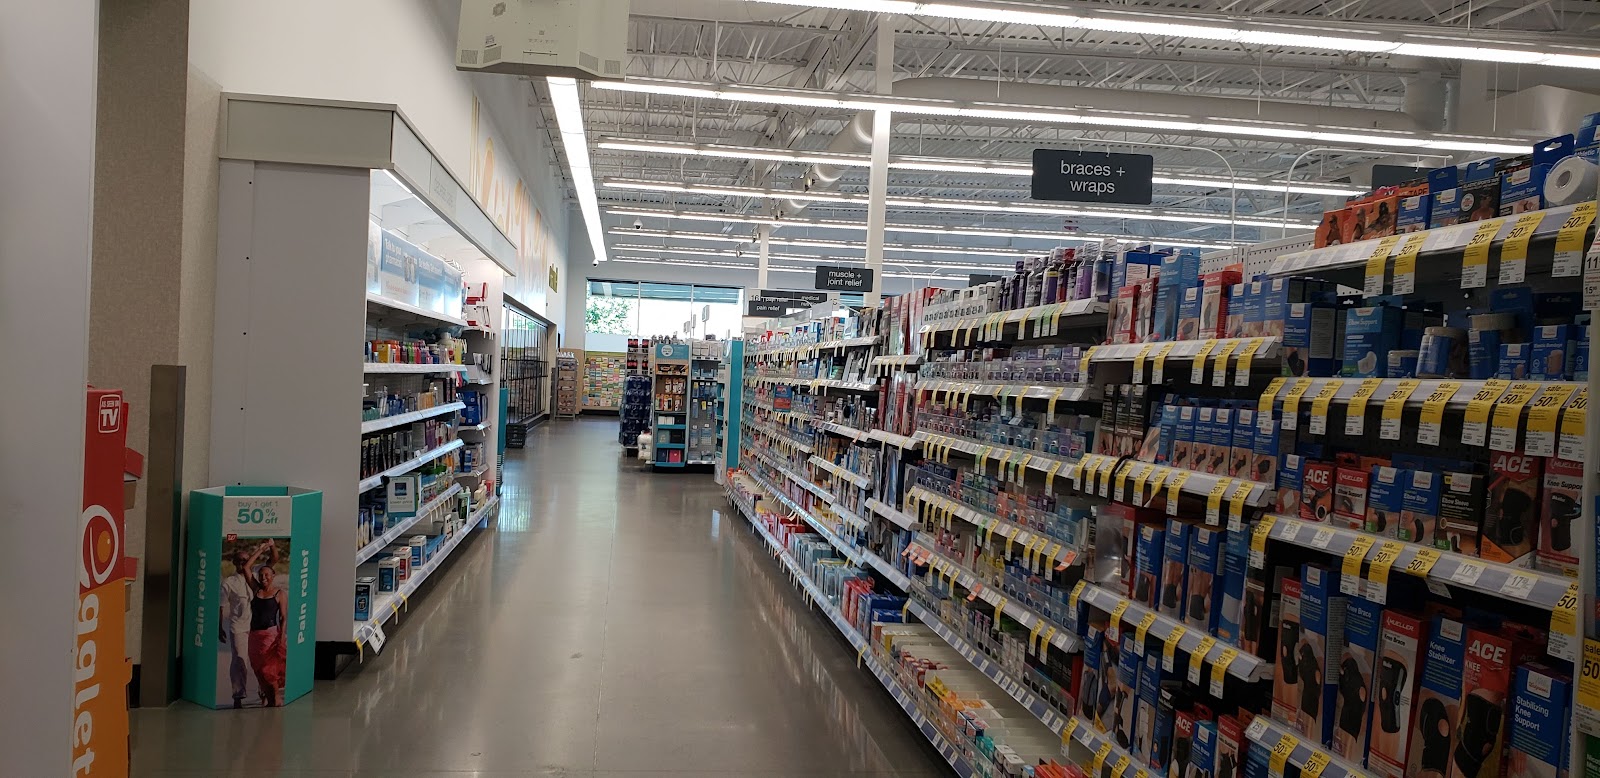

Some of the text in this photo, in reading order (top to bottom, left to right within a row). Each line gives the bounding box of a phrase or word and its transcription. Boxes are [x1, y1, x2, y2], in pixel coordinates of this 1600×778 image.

[1060, 160, 1111, 176] braces
[1069, 180, 1115, 196] wraps
[1574, 205, 1590, 213] sale
[1517, 216, 1532, 224] sale
[828, 270, 854, 279] muscle
[827, 278, 863, 287] joint relief
[1485, 379, 1499, 387] sale
[1512, 383, 1528, 391] sale
[1546, 385, 1563, 393] sale
[100, 408, 119, 427] TV
[1493, 455, 1533, 474] ACE
[1553, 460, 1583, 470] MUELLE
[1305, 468, 1329, 485] ACE
[1341, 473, 1364, 483] MUELLER
[1417, 548, 1430, 557] sale
[194, 549, 207, 647] Pain relief
[297, 549, 309, 644] Pain relief
[1557, 594, 1577, 609] 50
[1346, 603, 1372, 618] Knee Brace
[1389, 617, 1414, 632] MUELLER
[1393, 637, 1406, 646] Brace
[1429, 641, 1446, 652] Knee
[1427, 649, 1456, 666] Stabilizer
[1468, 639, 1507, 665] ACE
[1464, 659, 1481, 673] KNEE
[1582, 660, 1600, 680] 50
[1515, 705, 1532, 718] Knee
[1516, 695, 1550, 717] Stabilizing
[1175, 715, 1193, 733] ACE
[1514, 714, 1540, 731] Support
